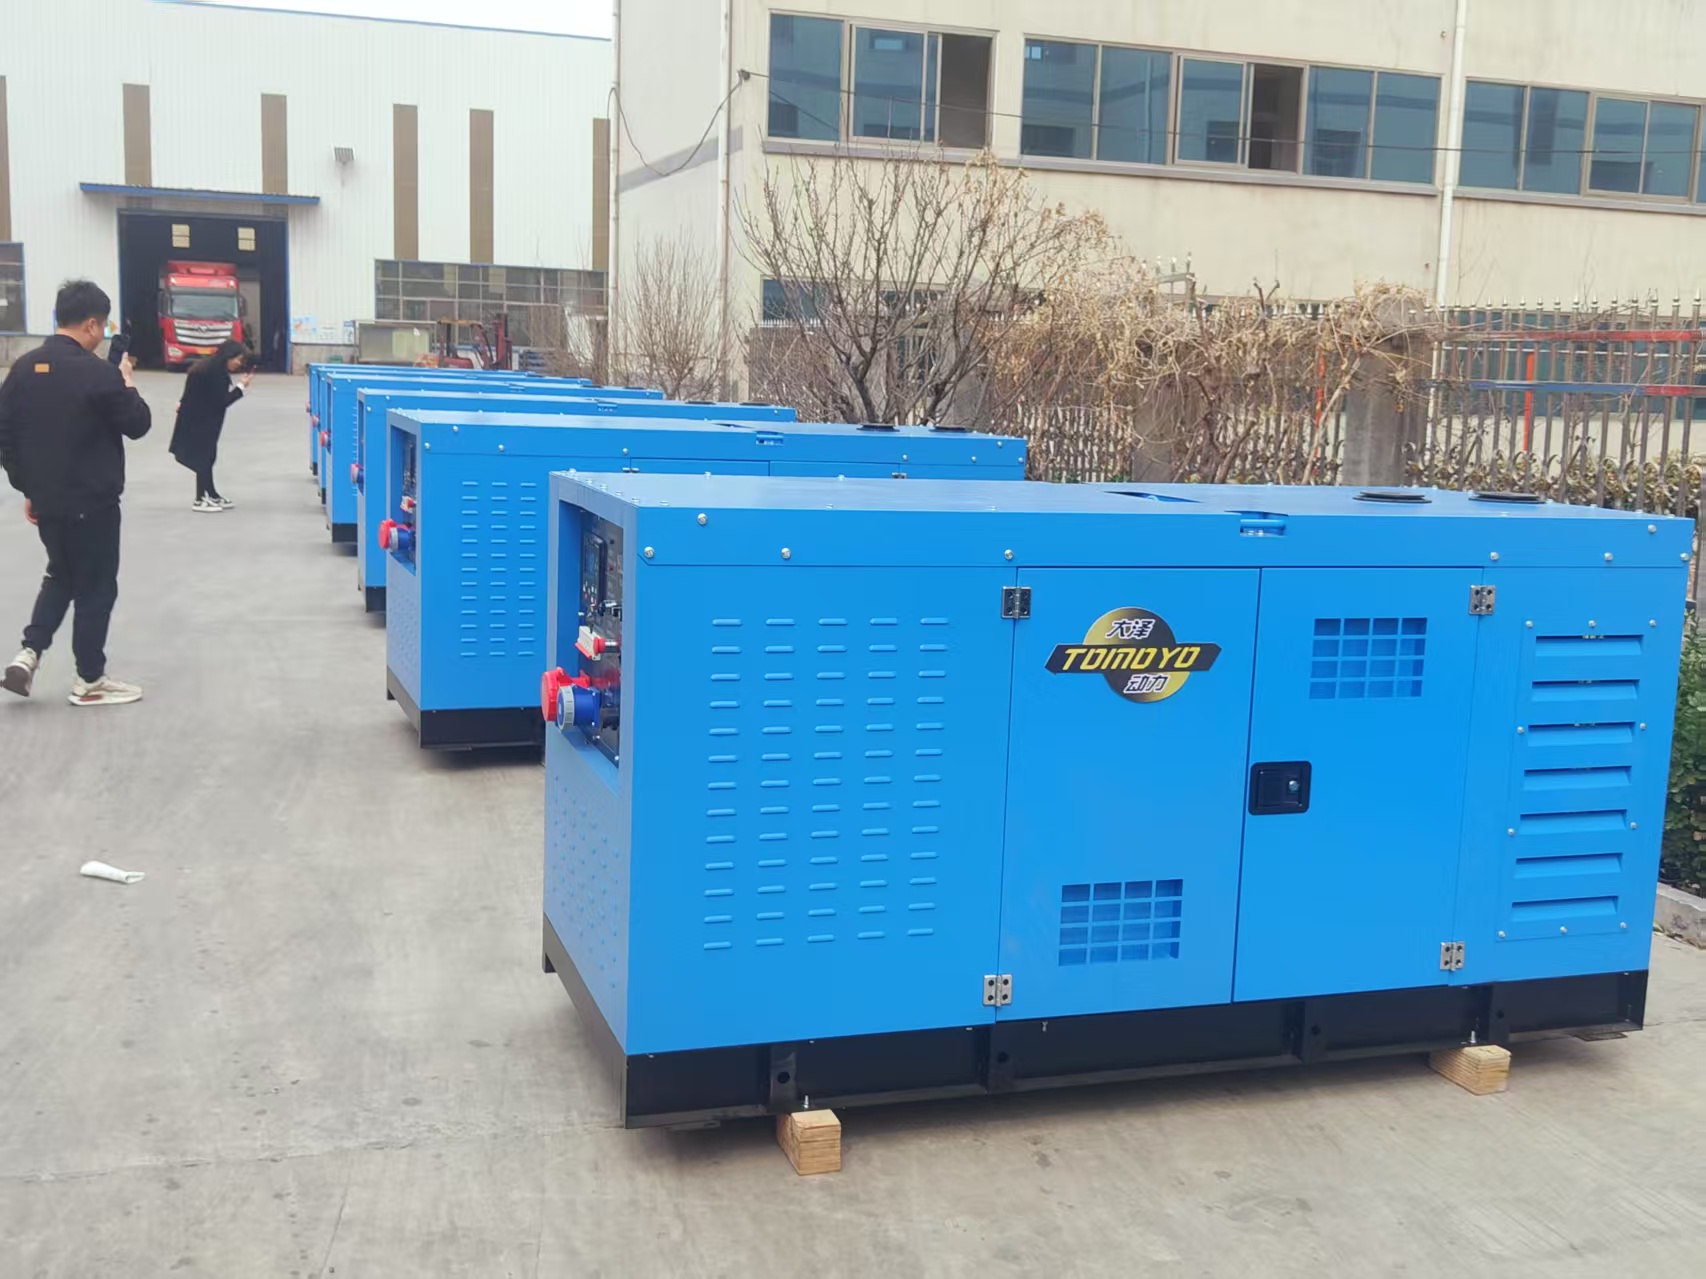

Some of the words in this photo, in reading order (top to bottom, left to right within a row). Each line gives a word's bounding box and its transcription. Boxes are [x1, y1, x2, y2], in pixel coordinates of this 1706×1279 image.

[1105, 619, 1155, 639] 大泽
[1062, 647, 1201, 671] TOMOYO
[1124, 674, 1169, 693] 动力
